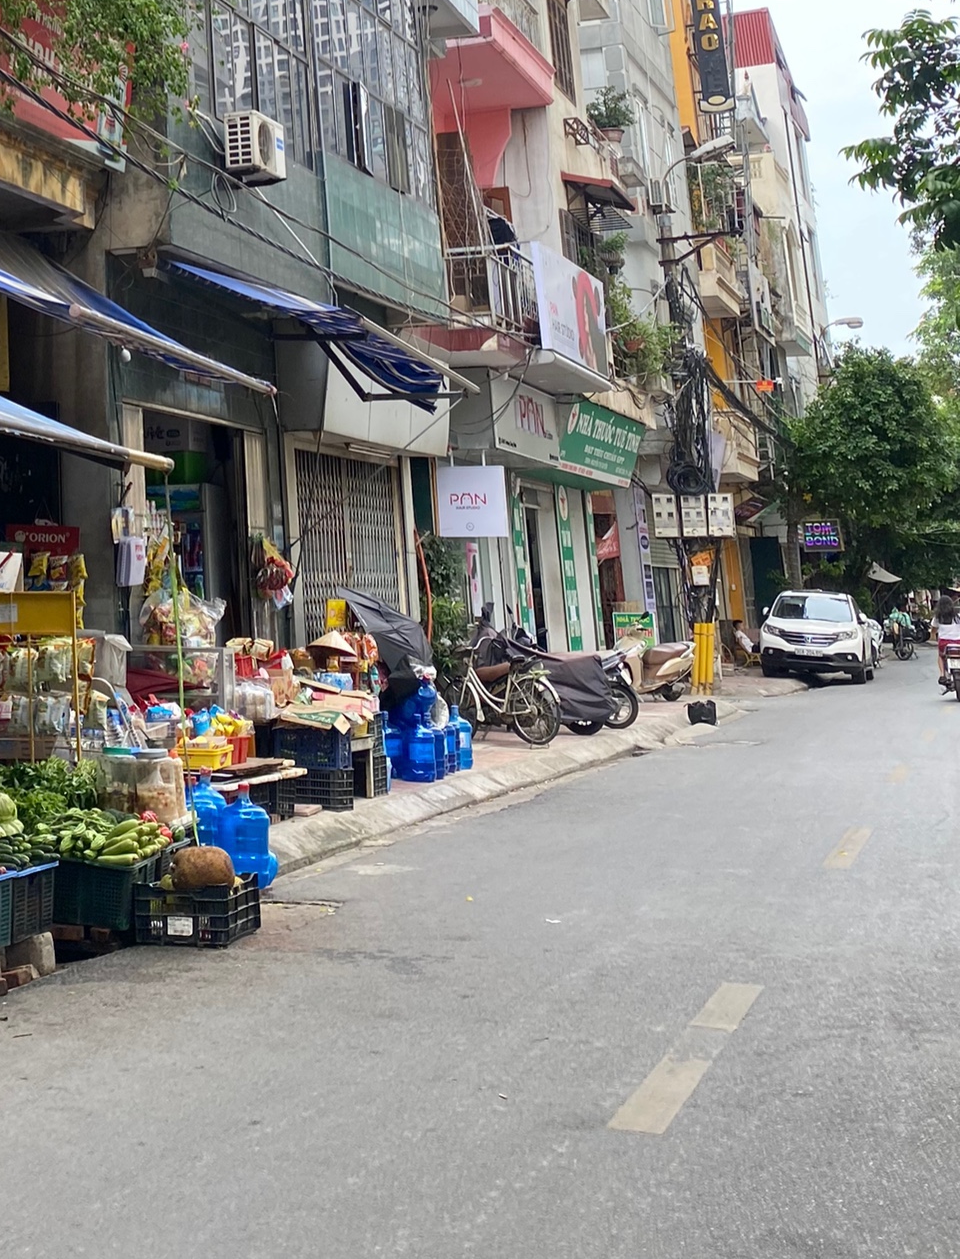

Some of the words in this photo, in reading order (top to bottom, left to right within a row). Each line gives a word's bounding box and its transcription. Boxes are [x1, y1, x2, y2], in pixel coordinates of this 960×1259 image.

[449, 493, 487, 506] PAN
[28, 532, 66, 544] ORION
[805, 536, 839, 546] BOND
